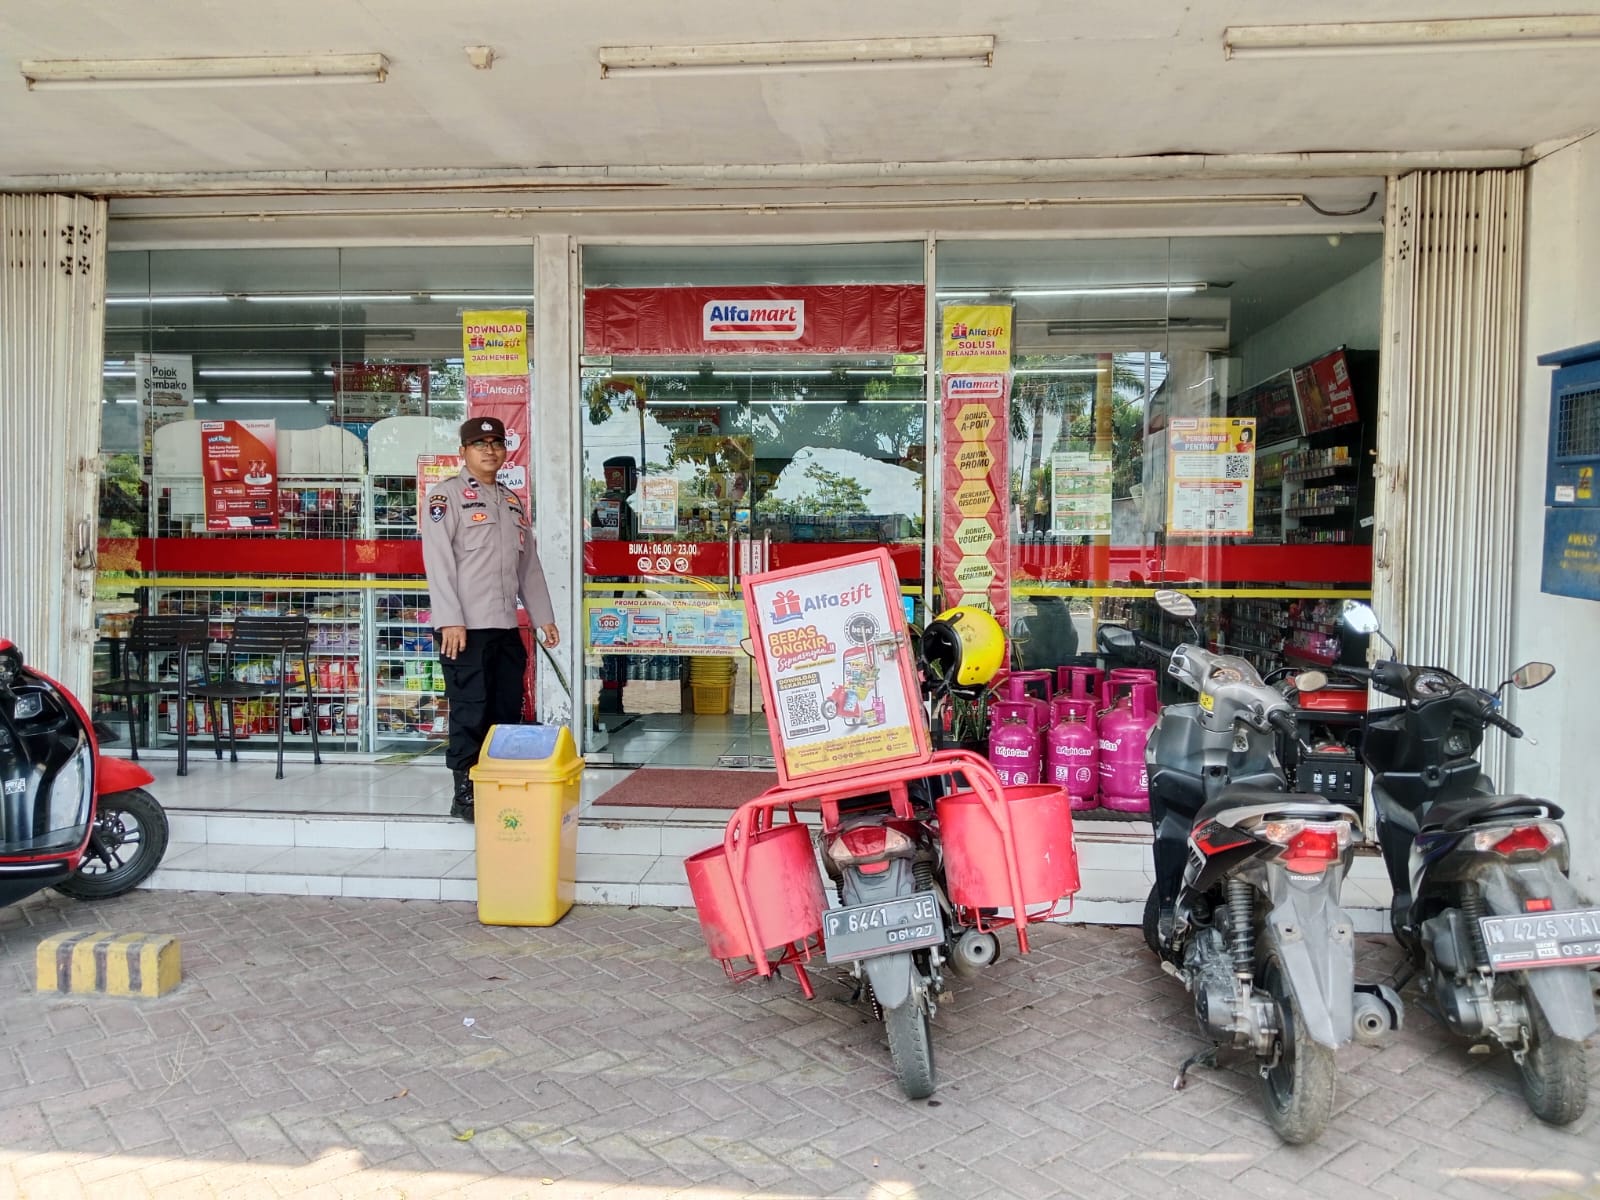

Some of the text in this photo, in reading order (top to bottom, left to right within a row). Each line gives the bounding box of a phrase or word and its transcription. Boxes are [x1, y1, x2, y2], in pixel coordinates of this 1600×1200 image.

[710, 305, 797, 322] Alfamart
[467, 324, 522, 334] DOWNLOAD
[969, 327, 1003, 337] Alfagift
[486, 339, 520, 348] Alfagift
[959, 341, 995, 349] SOLUSI
[152, 366, 177, 377] Pojok
[489, 384, 525, 396] Alfagift
[951, 380, 999, 389] Alfamart
[964, 411, 988, 421] BONUS
[960, 419, 990, 431] A-POIN
[1184, 442, 1215, 451] PENTING
[960, 450, 988, 461] BANYAK
[960, 458, 990, 470] PROMO
[958, 496, 991, 507] DISCOUNT
[965, 526, 986, 536] BONUS
[958, 533, 992, 545] VOUCHER
[653, 544, 672, 554] 06.00
[678, 543, 697, 554] 23.00
[804, 583, 872, 612] Alfagift
[851, 625, 873, 634] ben!
[769, 625, 817, 646] BEBAS
[771, 636, 827, 657] ONGKIR
[779, 673, 817, 685] DOWNLOAD
[829, 901, 933, 936] P 6441 JE
[1489, 925, 1505, 943] N
[1513, 920, 1559, 941] 4245
